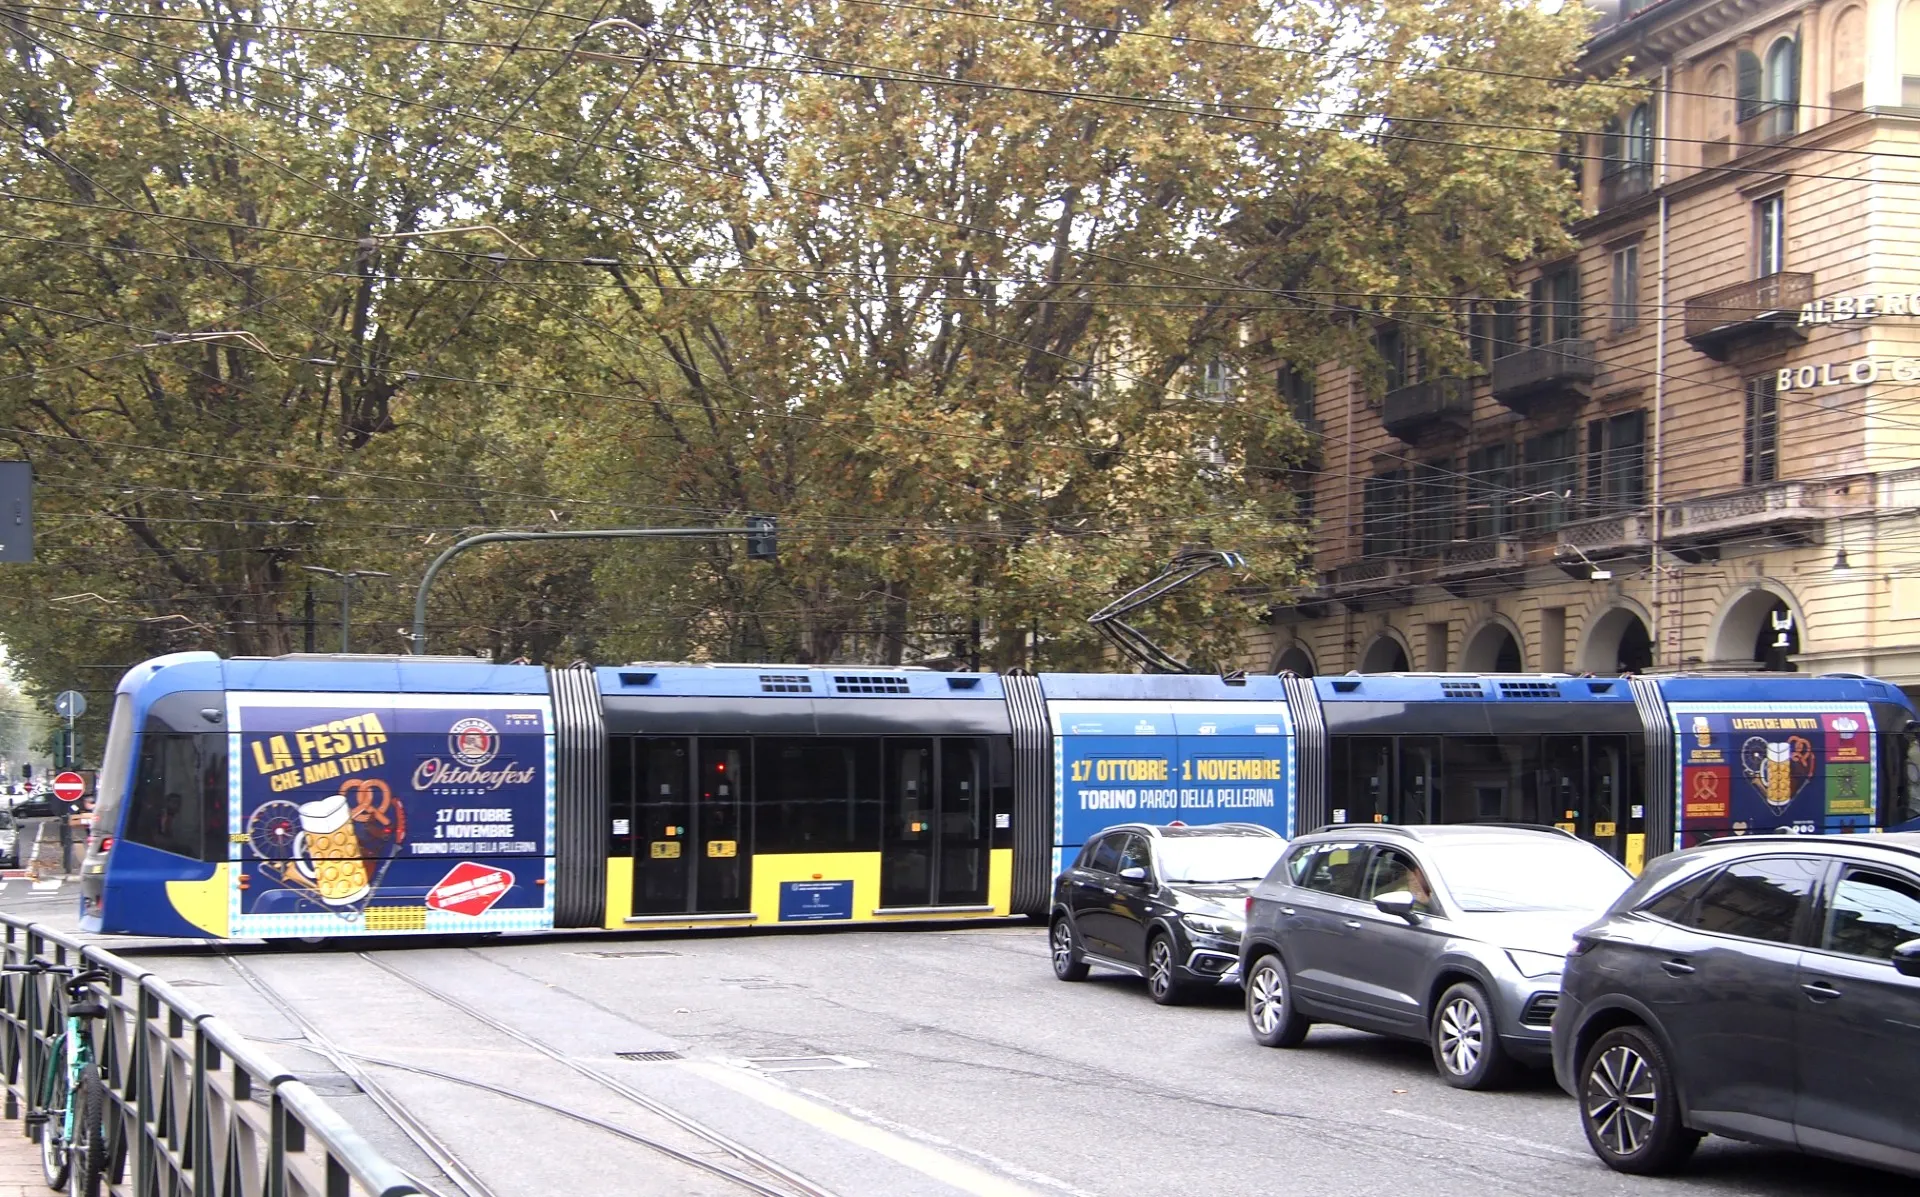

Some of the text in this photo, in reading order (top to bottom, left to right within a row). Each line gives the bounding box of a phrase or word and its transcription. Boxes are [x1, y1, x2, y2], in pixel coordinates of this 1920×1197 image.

[251, 712, 387, 774] LA FESTA
[270, 748, 385, 792] CHE AMA TUTTI
[411, 757, 536, 790] Oktoberfest
[1071, 759, 1092, 782] 17
[1096, 759, 1168, 781] OTTOBRE
[1182, 759, 1192, 781] 1
[1197, 758, 1281, 780] NOVEMBRE
[1078, 788, 1274, 810] TORINO PARCO DELLA PELLERINA
[436, 808, 512, 822] 17 OTTOBRE
[434, 824, 514, 838] 1 NOVEMBRE
[410, 842, 448, 854] TORINO
[449, 842, 474, 853] PARCO
[498, 841, 537, 853] PELLERINA
